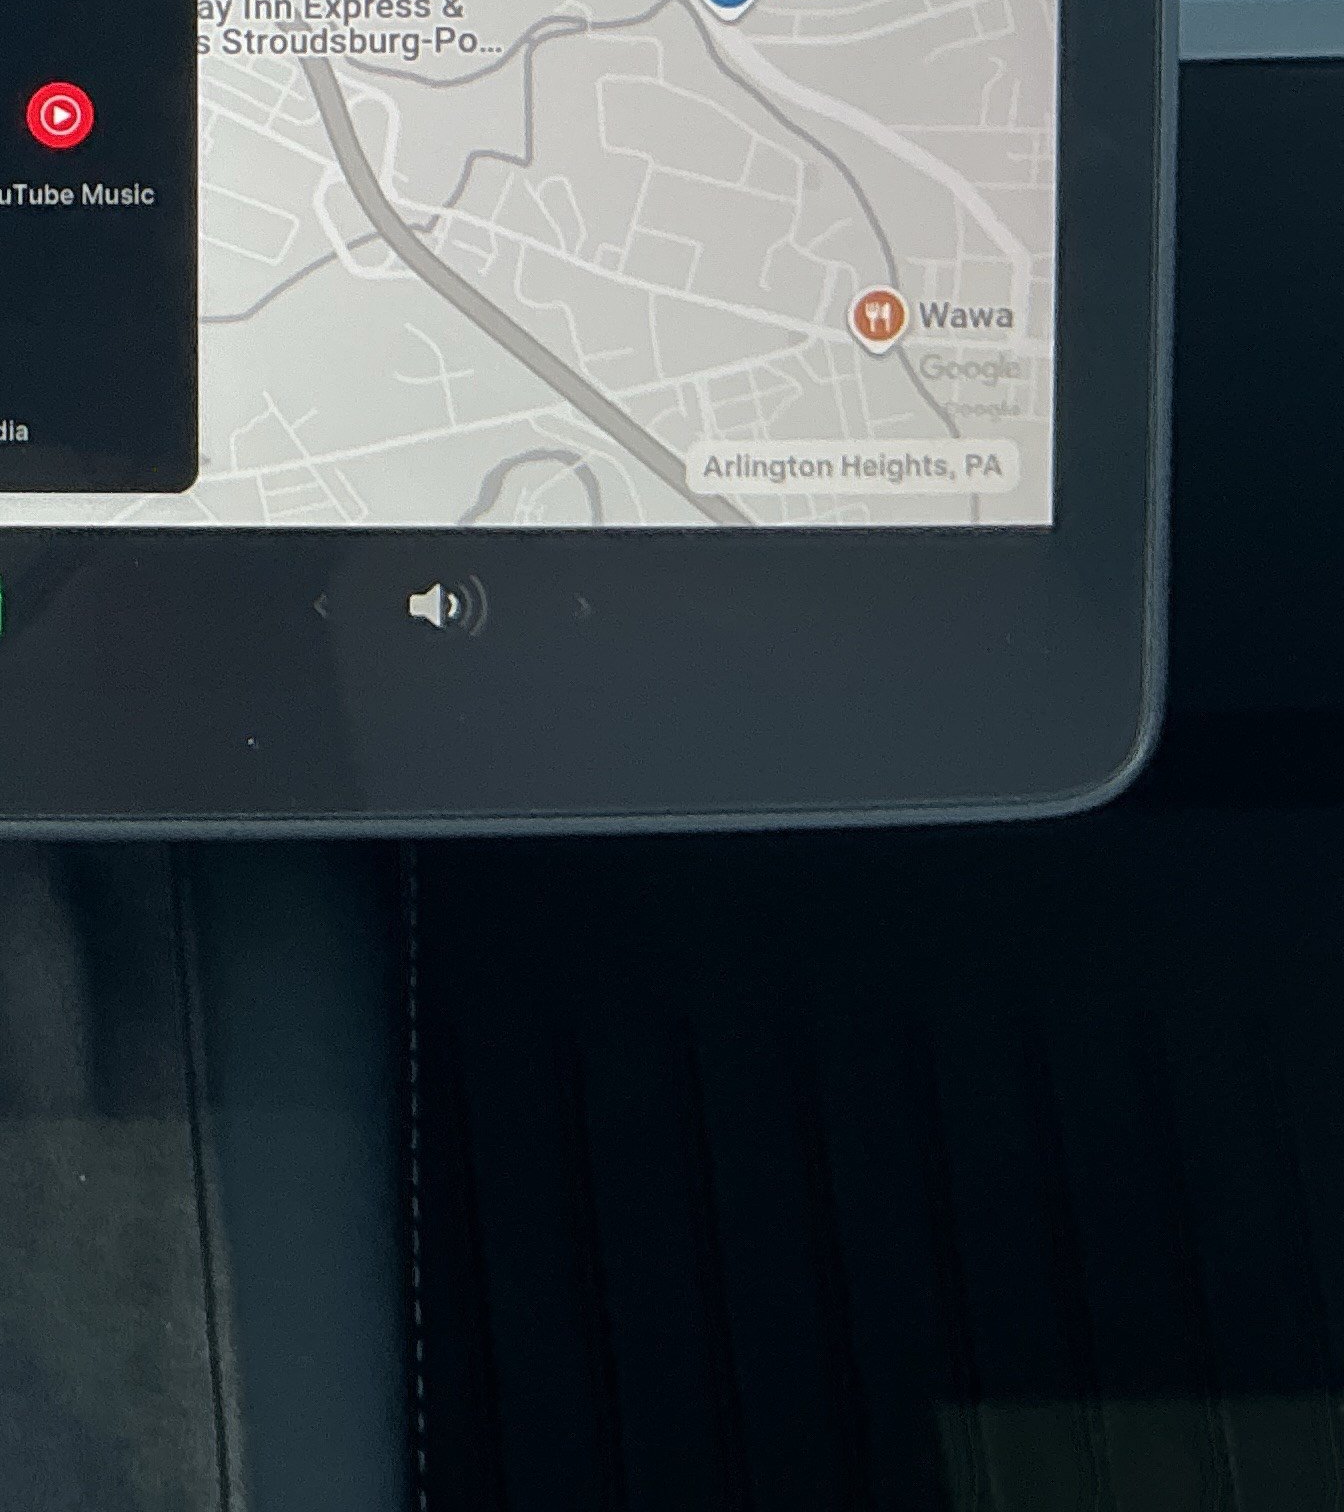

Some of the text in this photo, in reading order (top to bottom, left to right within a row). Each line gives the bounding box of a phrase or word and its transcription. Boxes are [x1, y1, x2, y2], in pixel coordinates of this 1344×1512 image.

[81, 182, 155, 206] Music
[919, 301, 1014, 329] Wawa
[919, 354, 1022, 388] Google
[703, 452, 1003, 484] Arlington Heights, PA
